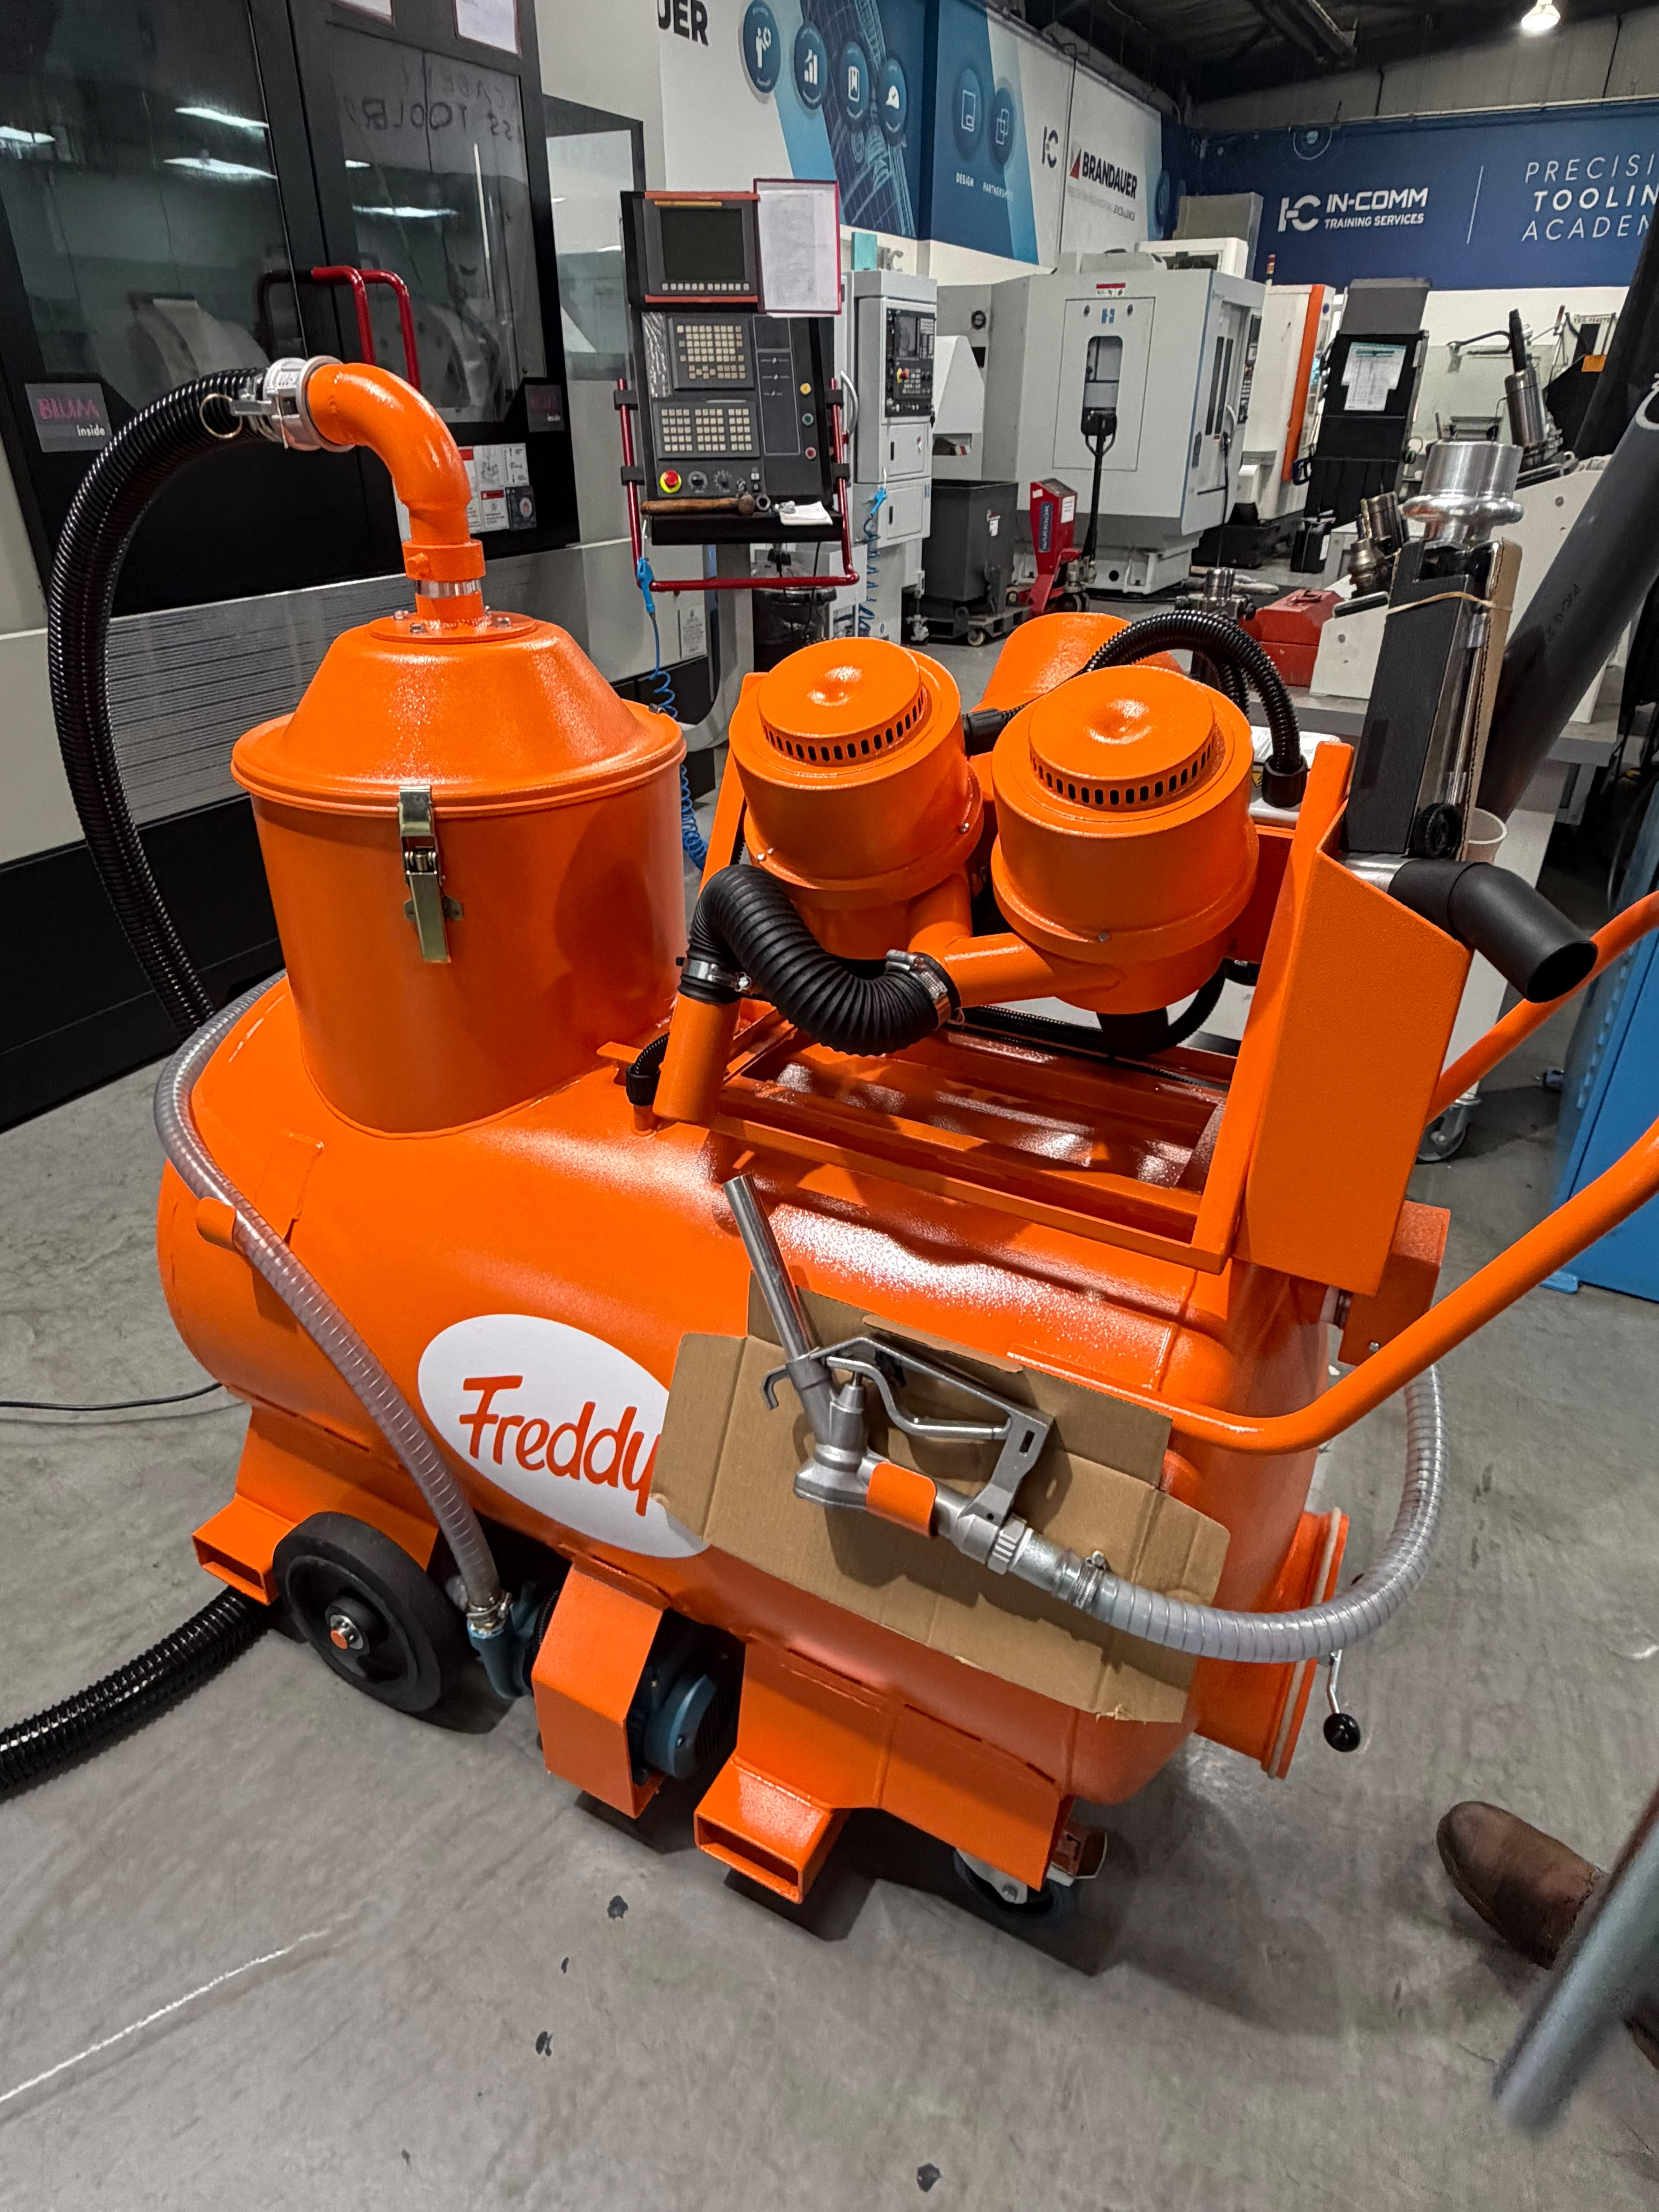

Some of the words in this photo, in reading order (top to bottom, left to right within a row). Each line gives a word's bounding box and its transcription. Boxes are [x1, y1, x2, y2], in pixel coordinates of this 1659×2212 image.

[1082, 151, 1138, 200] BRANDAUER
[1525, 152, 1656, 183] PRECISI
[1326, 188, 1429, 213] IN-COMM
[1324, 216, 1372, 230] TRAINING
[1373, 213, 1425, 227] SERVICES
[37, 397, 101, 420] BLUM
[76, 424, 105, 436] inside
[458, 1374, 661, 1517] Freddy
